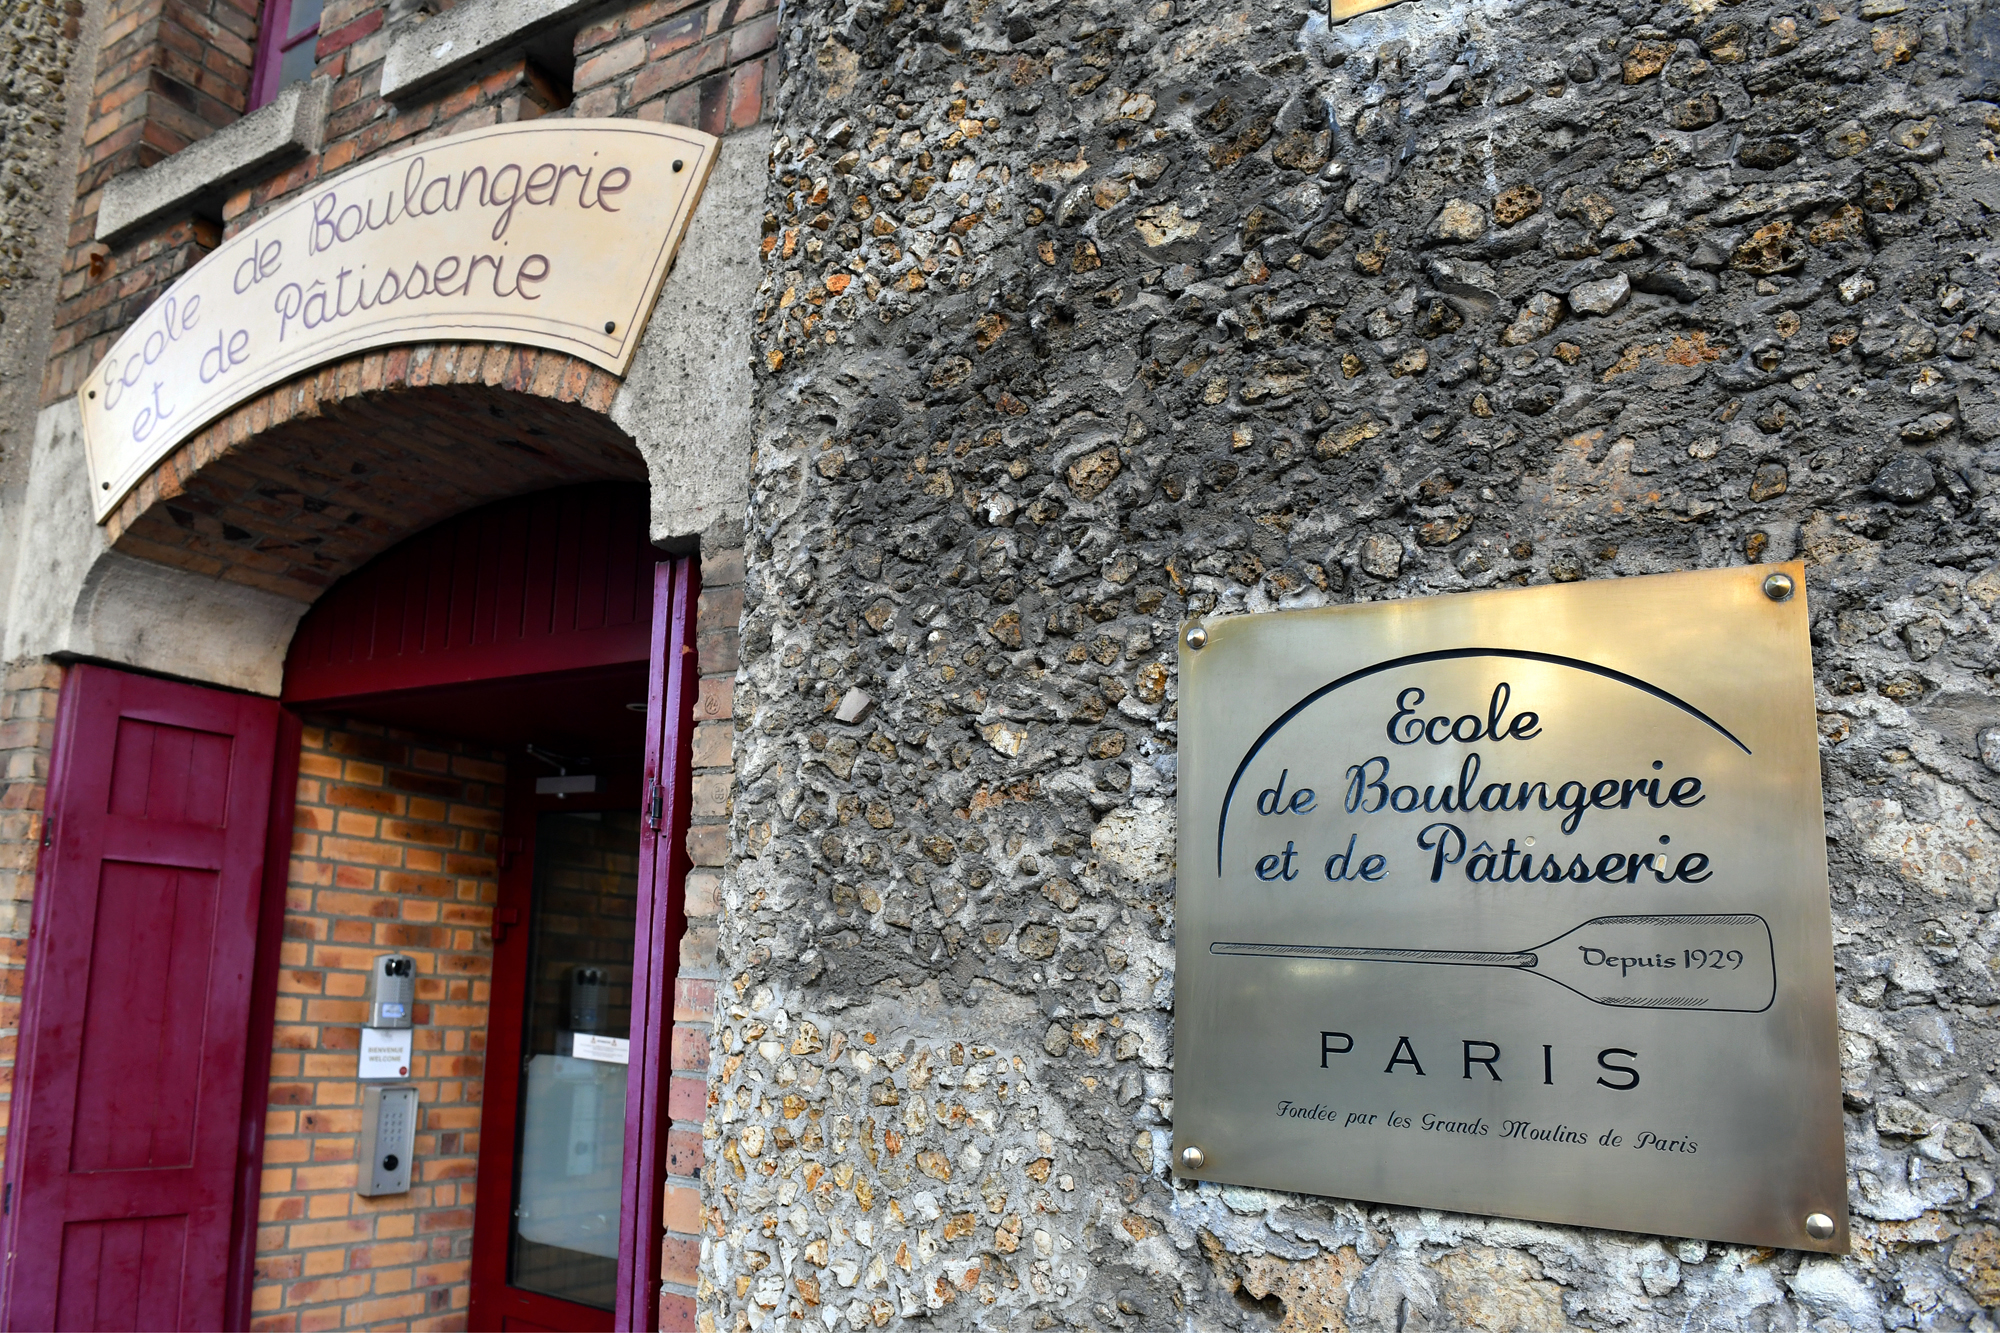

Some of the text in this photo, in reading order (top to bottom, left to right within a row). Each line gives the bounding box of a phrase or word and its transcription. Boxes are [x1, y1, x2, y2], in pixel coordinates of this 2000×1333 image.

[104, 151, 632, 411] Ecole de Boulangerie
[132, 240, 551, 442] et de Pâtisserie
[1386, 681, 1543, 746] Ecole
[1255, 752, 1707, 836] de Boulangerie
[1253, 822, 1714, 885] et de Pâtisserie
[1578, 945, 1744, 978] Depuis 1929
[368, 1046, 404, 1054] BIENVENUE
[1319, 1030, 1641, 1091] PARIS
[1275, 1099, 1699, 1154] Fondée par les Grands Moulins de Paris
